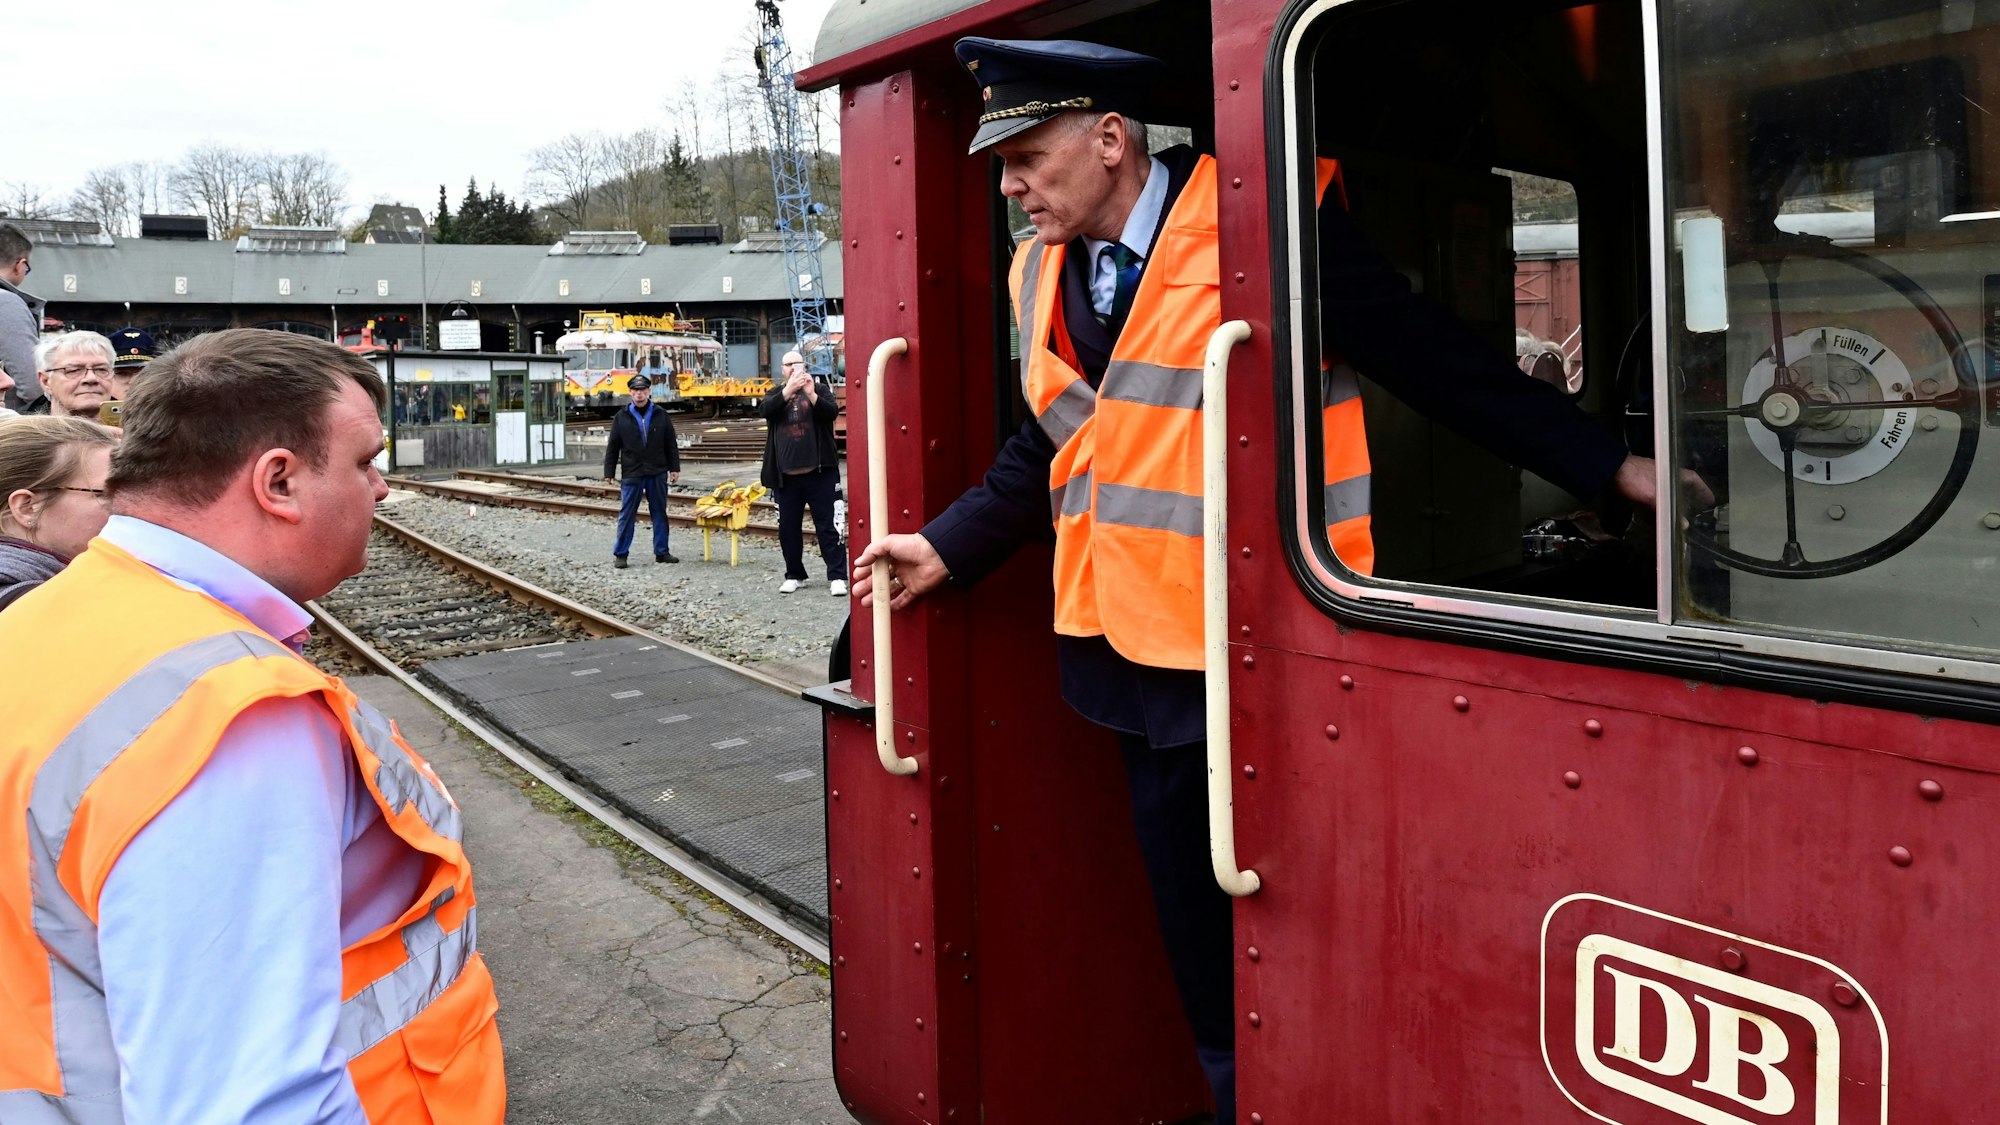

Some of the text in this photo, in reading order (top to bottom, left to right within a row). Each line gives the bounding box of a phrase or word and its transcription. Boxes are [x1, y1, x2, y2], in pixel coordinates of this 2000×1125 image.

[66, 276, 76, 291] 2
[177, 278, 186, 293] 3
[281, 279, 289, 293] 4
[379, 281, 387, 295] 5
[472, 281, 480, 295] 6
[1833, 335, 1869, 357] Füllen
[1880, 411, 1907, 449] Fahren
[1603, 964, 1795, 1116] DB
